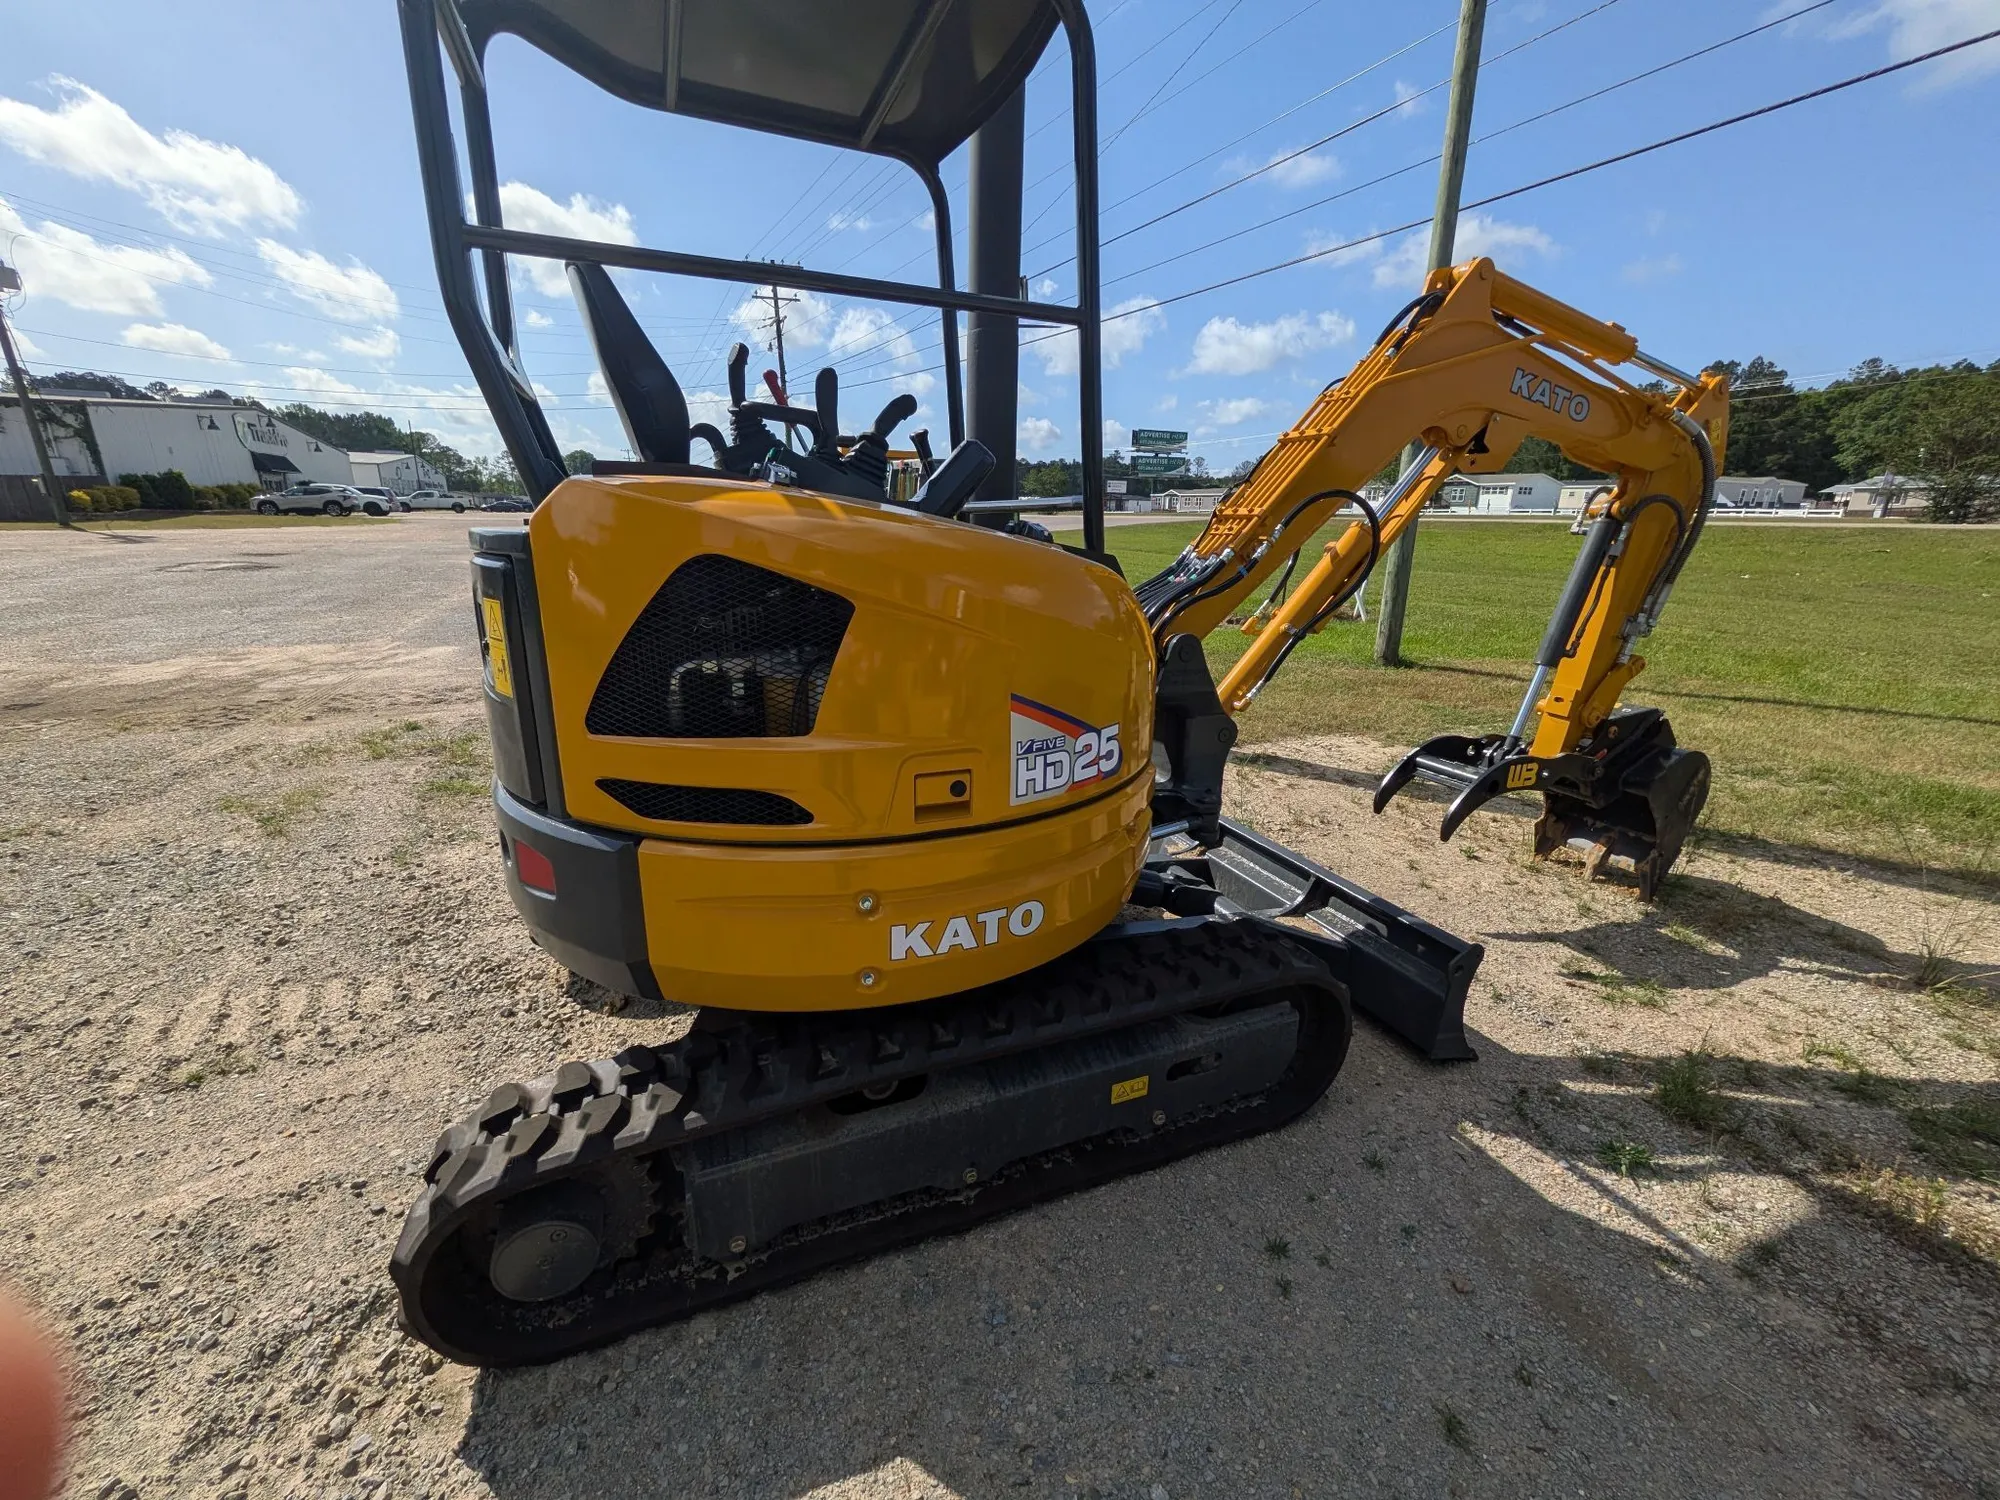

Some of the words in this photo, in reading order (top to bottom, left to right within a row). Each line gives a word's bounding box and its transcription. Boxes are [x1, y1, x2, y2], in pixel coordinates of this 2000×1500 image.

[1510, 367, 1590, 422] KATO
[1140, 431, 1170, 439] ADVERTISE
[889, 899, 1045, 961] KATO
